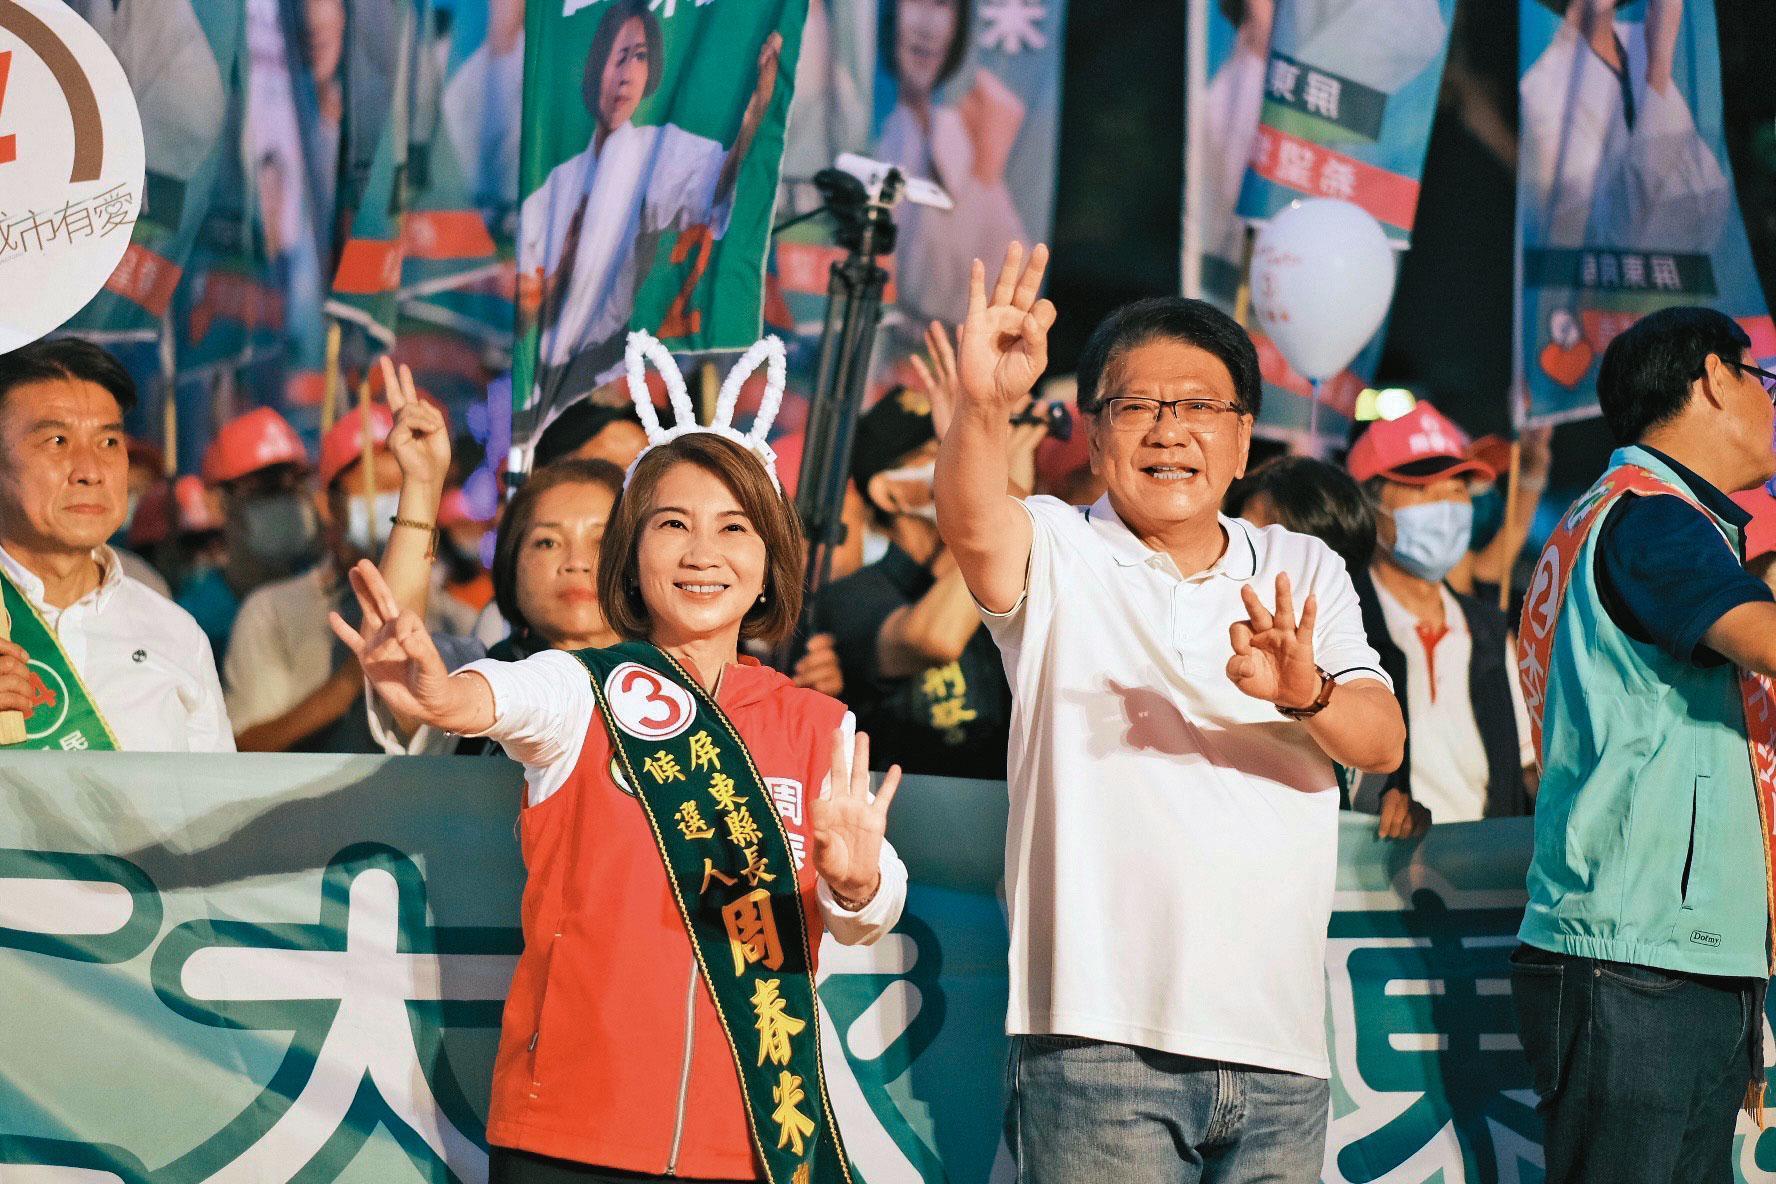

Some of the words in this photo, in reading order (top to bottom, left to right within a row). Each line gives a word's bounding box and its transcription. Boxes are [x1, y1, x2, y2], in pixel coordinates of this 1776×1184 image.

[621, 670, 681, 730] 3
[643, 750, 738, 895] 候選人
[688, 730, 777, 887] 屏東縣長
[721, 888, 815, 1157] 周春米
